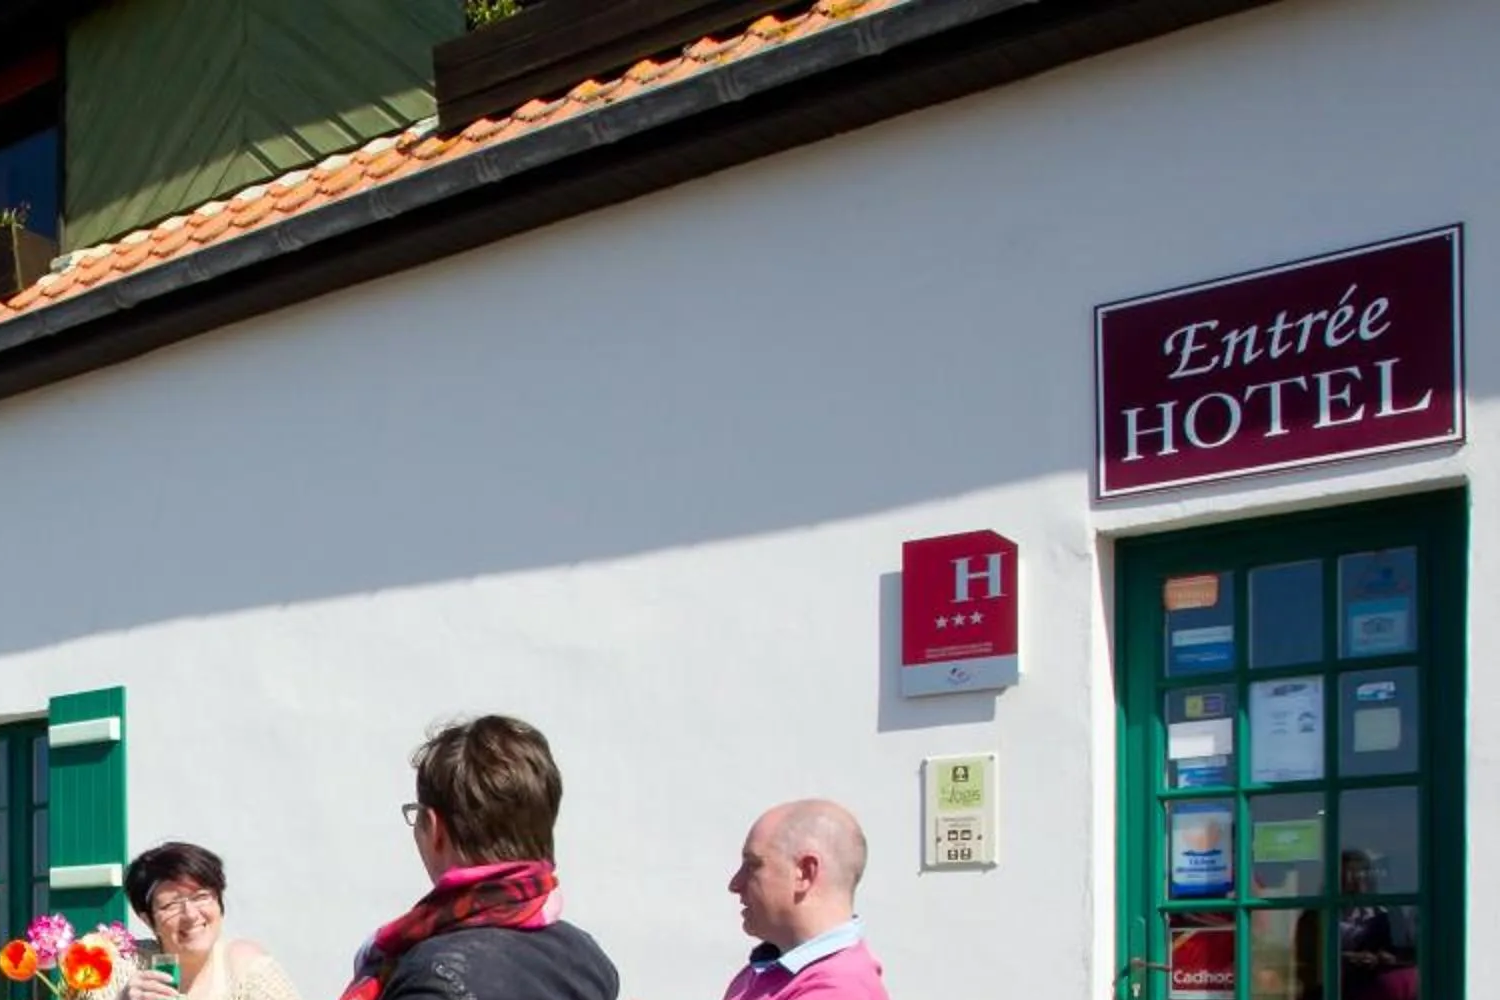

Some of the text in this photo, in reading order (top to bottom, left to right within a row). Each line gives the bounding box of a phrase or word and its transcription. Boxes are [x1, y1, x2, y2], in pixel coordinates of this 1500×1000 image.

[1163, 282, 1392, 379] Entrée
[1120, 357, 1434, 462] HOTEL
[949, 552, 1009, 603] H
